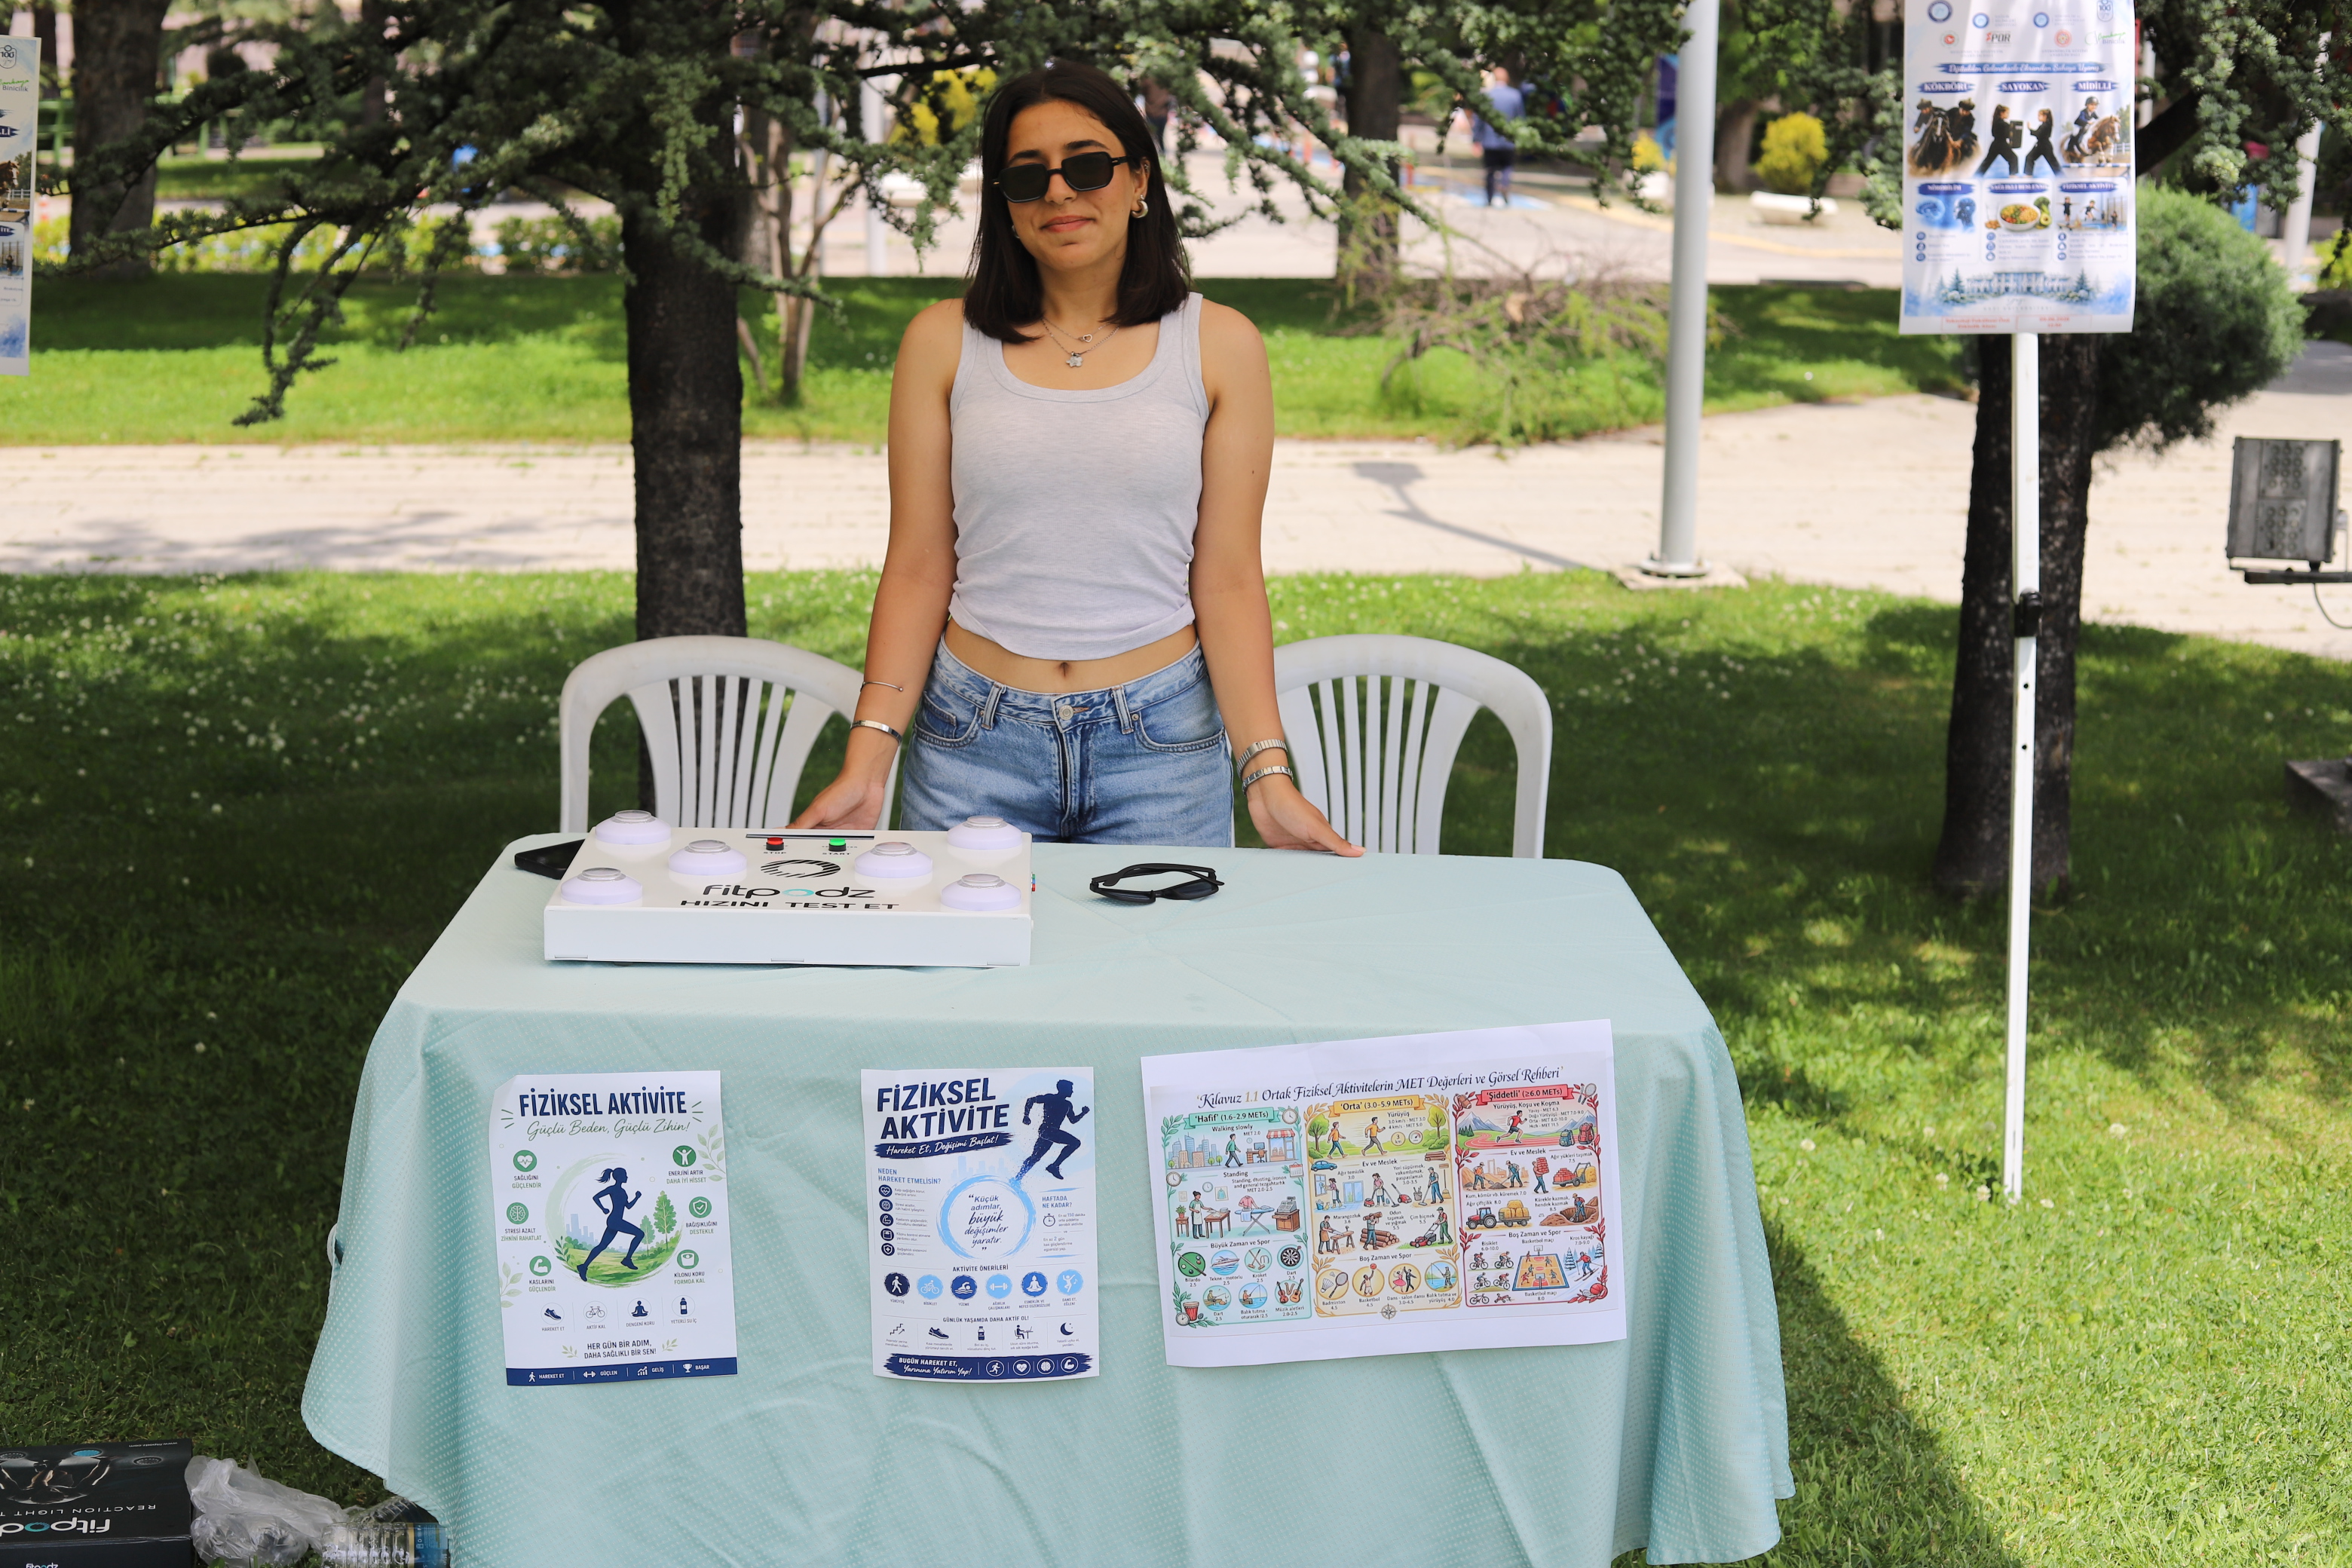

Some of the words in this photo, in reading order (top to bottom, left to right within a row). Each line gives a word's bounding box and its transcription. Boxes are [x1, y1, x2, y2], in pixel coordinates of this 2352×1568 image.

[703, 884, 876, 899] fitpodz
[1245, 1090, 1259, 1103] 1.1
[1262, 1089, 1291, 1101] Ortak
[1294, 1083, 1334, 1101] Fiziksel
[1333, 1079, 1393, 1098] Aktivitelerin
[1395, 1076, 1425, 1092] MET
[1427, 1072, 1472, 1090] Değerleri
[1475, 1075, 1486, 1084] ve
[1488, 1068, 1519, 1087] Görsel
[877, 1077, 997, 1112] FİZİKSEL
[1542, 1088, 1563, 1096] METs)
[519, 1088, 602, 1117] FİZİKSEL
[608, 1086, 687, 1115] AKTİVİTE
[1392, 1098, 1413, 1107] METs)
[1248, 1110, 1269, 1119] METs)
[880, 1104, 1010, 1140] AKTİVİTE
[527, 1120, 566, 1141] Güçlü
[568, 1119, 610, 1135] Beden,
[614, 1119, 651, 1139] Güçlü
[653, 1119, 691, 1133] Zihin!
[886, 1145, 917, 1156] Hareket
[918, 1144, 932, 1154] Et,
[935, 1140, 967, 1153] Değişimi
[969, 1135, 1000, 1147] Başlat!
[878, 1175, 905, 1184] HAREKET
[512, 1181, 542, 1190] GÜÇLENDİR
[970, 1203, 1002, 1211] adımlar,
[968, 1209, 1004, 1228] büyük
[964, 1223, 1009, 1239] değişimler
[971, 1236, 1002, 1248] yaratır.
[979, 1263, 1009, 1272] ÖNERİLERİ
[602, 1341, 617, 1349] GÜN
[619, 1340, 630, 1348] BİR
[632, 1339, 652, 1347] ADIM,
[602, 1349, 629, 1358] SAĞLIKLI
[631, 1348, 642, 1356] BİR
[899, 1357, 919, 1365] BUGÜN
[920, 1358, 948, 1367] HAREKET
[957, 1367, 972, 1377] Yap!
[72, 1505, 156, 1514] REACTION
